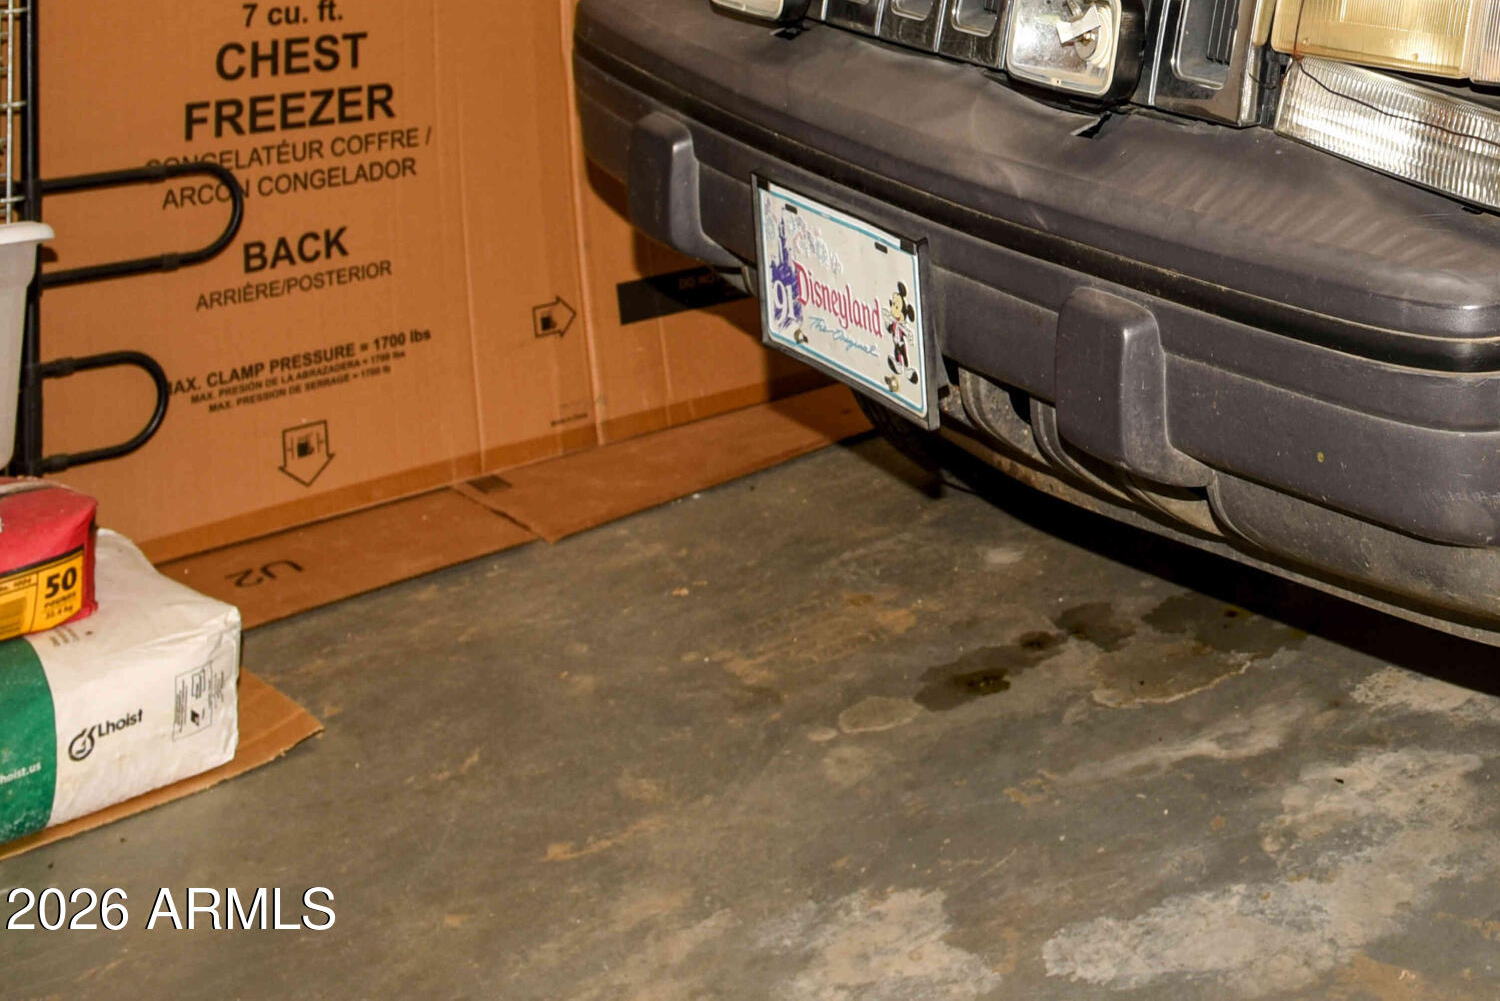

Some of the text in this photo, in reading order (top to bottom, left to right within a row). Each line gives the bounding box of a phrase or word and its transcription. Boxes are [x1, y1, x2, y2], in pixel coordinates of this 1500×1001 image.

[242, 3, 258, 28] 7
[267, 6, 308, 27] cu.
[216, 32, 368, 81] CHEST
[184, 83, 396, 141] FREEZER
[330, 128, 419, 158] COFFRE
[257, 157, 417, 198] CONGELADOR
[243, 226, 349, 274] BACK
[774, 281, 797, 323] 91
[793, 260, 883, 338] Disneyland
[206, 362, 265, 388] CLAMP
[269, 343, 356, 374] PRESSURE
[373, 332, 406, 351] 1700
[410, 329, 431, 344] lbs
[832, 328, 879, 358] Original
[44, 566, 77, 599] 50
[98, 709, 143, 738] Lhoist
